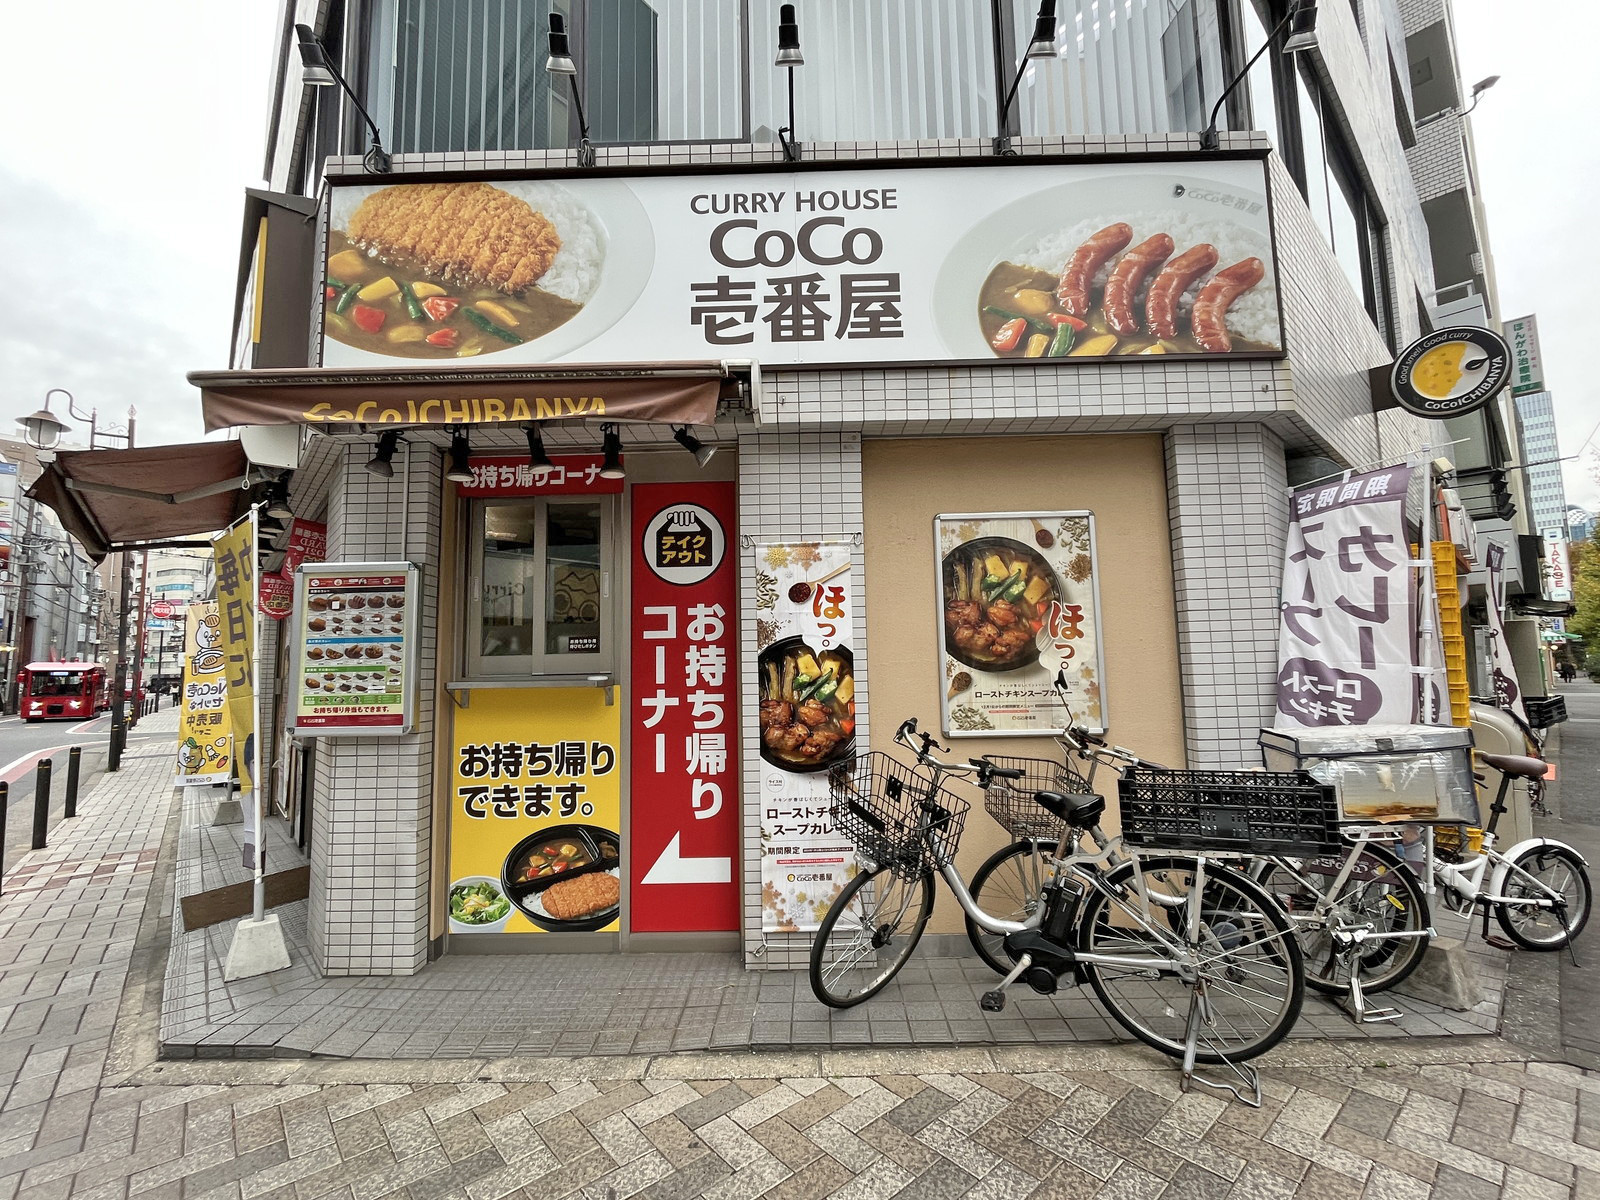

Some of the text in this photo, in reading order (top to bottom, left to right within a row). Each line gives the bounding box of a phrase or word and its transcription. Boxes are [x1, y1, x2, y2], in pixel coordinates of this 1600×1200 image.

[690, 188, 898, 214] CURRY HOUSE
[709, 216, 883, 268] CoCo
[690, 272, 904, 345] 壱番屋
[1399, 365, 1410, 385] Good
[1423, 332, 1448, 348] Good
[1448, 331, 1474, 340] curry
[1424, 355, 1503, 410] CoCoICHIBANYA
[662, 535, 706, 549] テイク
[662, 550, 706, 564] アウト
[1549, 543, 1565, 588] TAKASE
[813, 583, 846, 647] ほっ。
[1050, 601, 1085, 669] ほっ。
[641, 606, 679, 773] コーナー
[685, 603, 727, 820] お持ち帰り
[975, 690, 1072, 698] ローストチキンスープカレー
[459, 741, 615, 779] お持ち帰り
[459, 783, 593, 818] できます。
[767, 846, 800, 855] 期間限定
